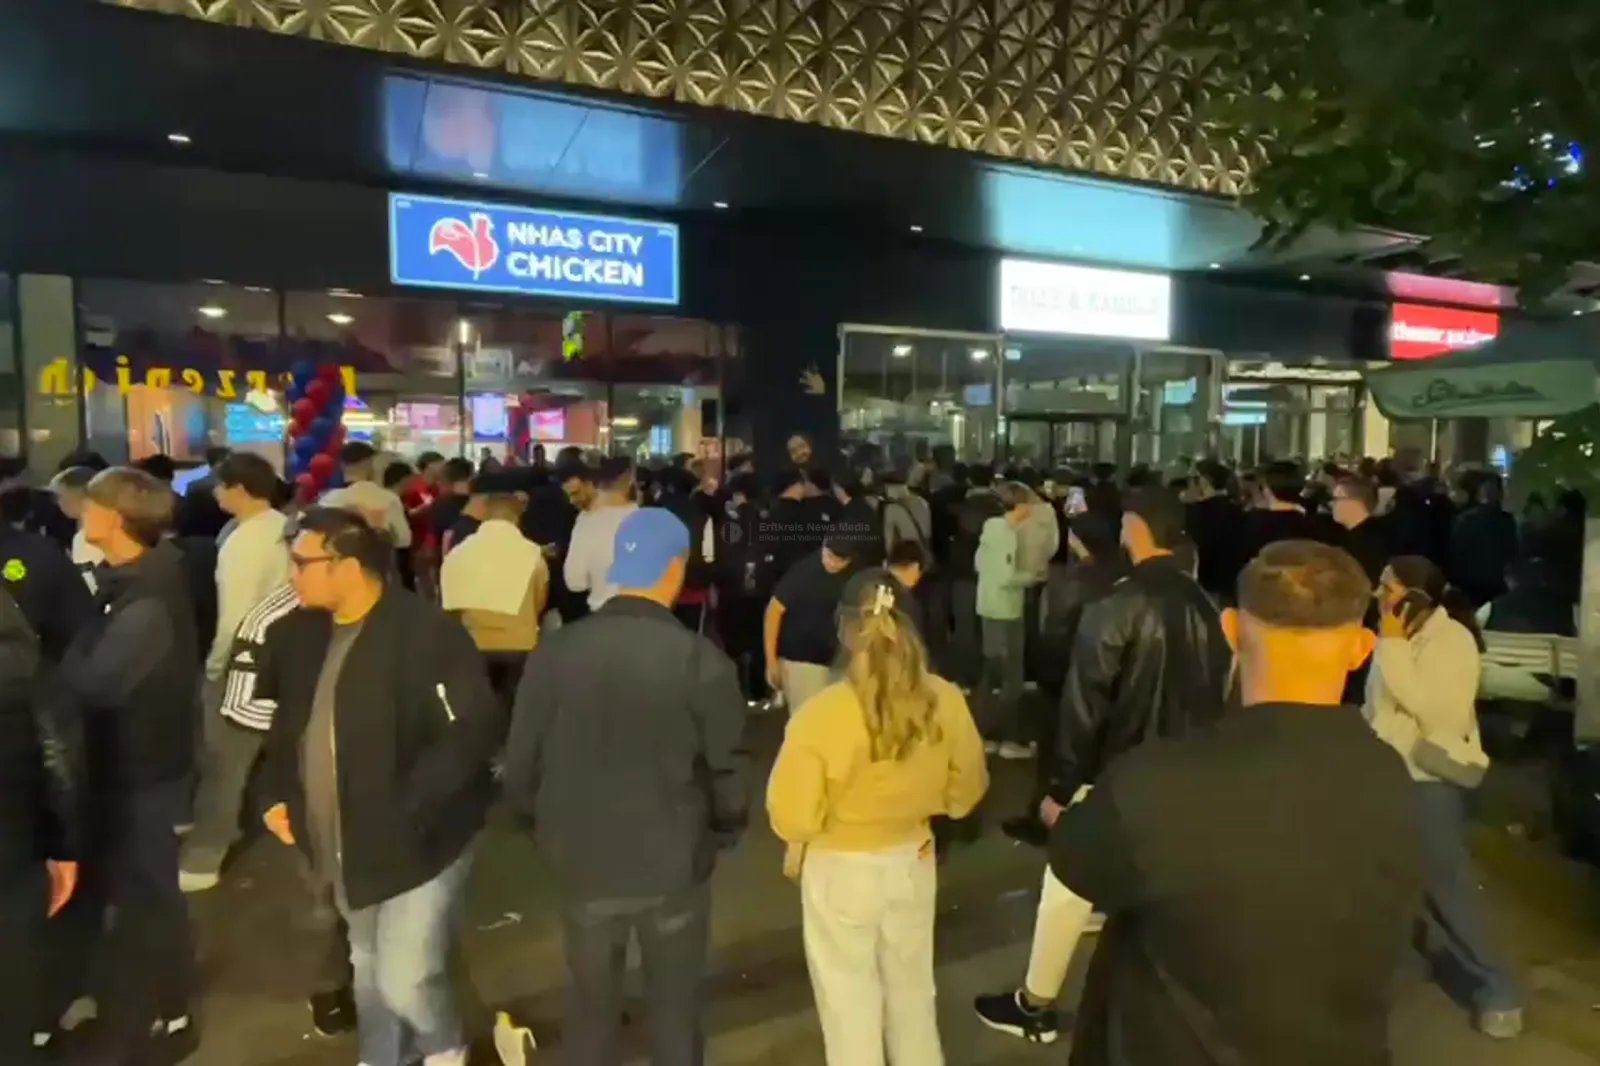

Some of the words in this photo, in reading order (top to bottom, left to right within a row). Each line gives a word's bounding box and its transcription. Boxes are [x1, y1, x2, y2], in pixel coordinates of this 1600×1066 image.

[507, 221, 582, 249] NHAS
[588, 230, 644, 255] CITY
[506, 251, 644, 287] CHICKEN
